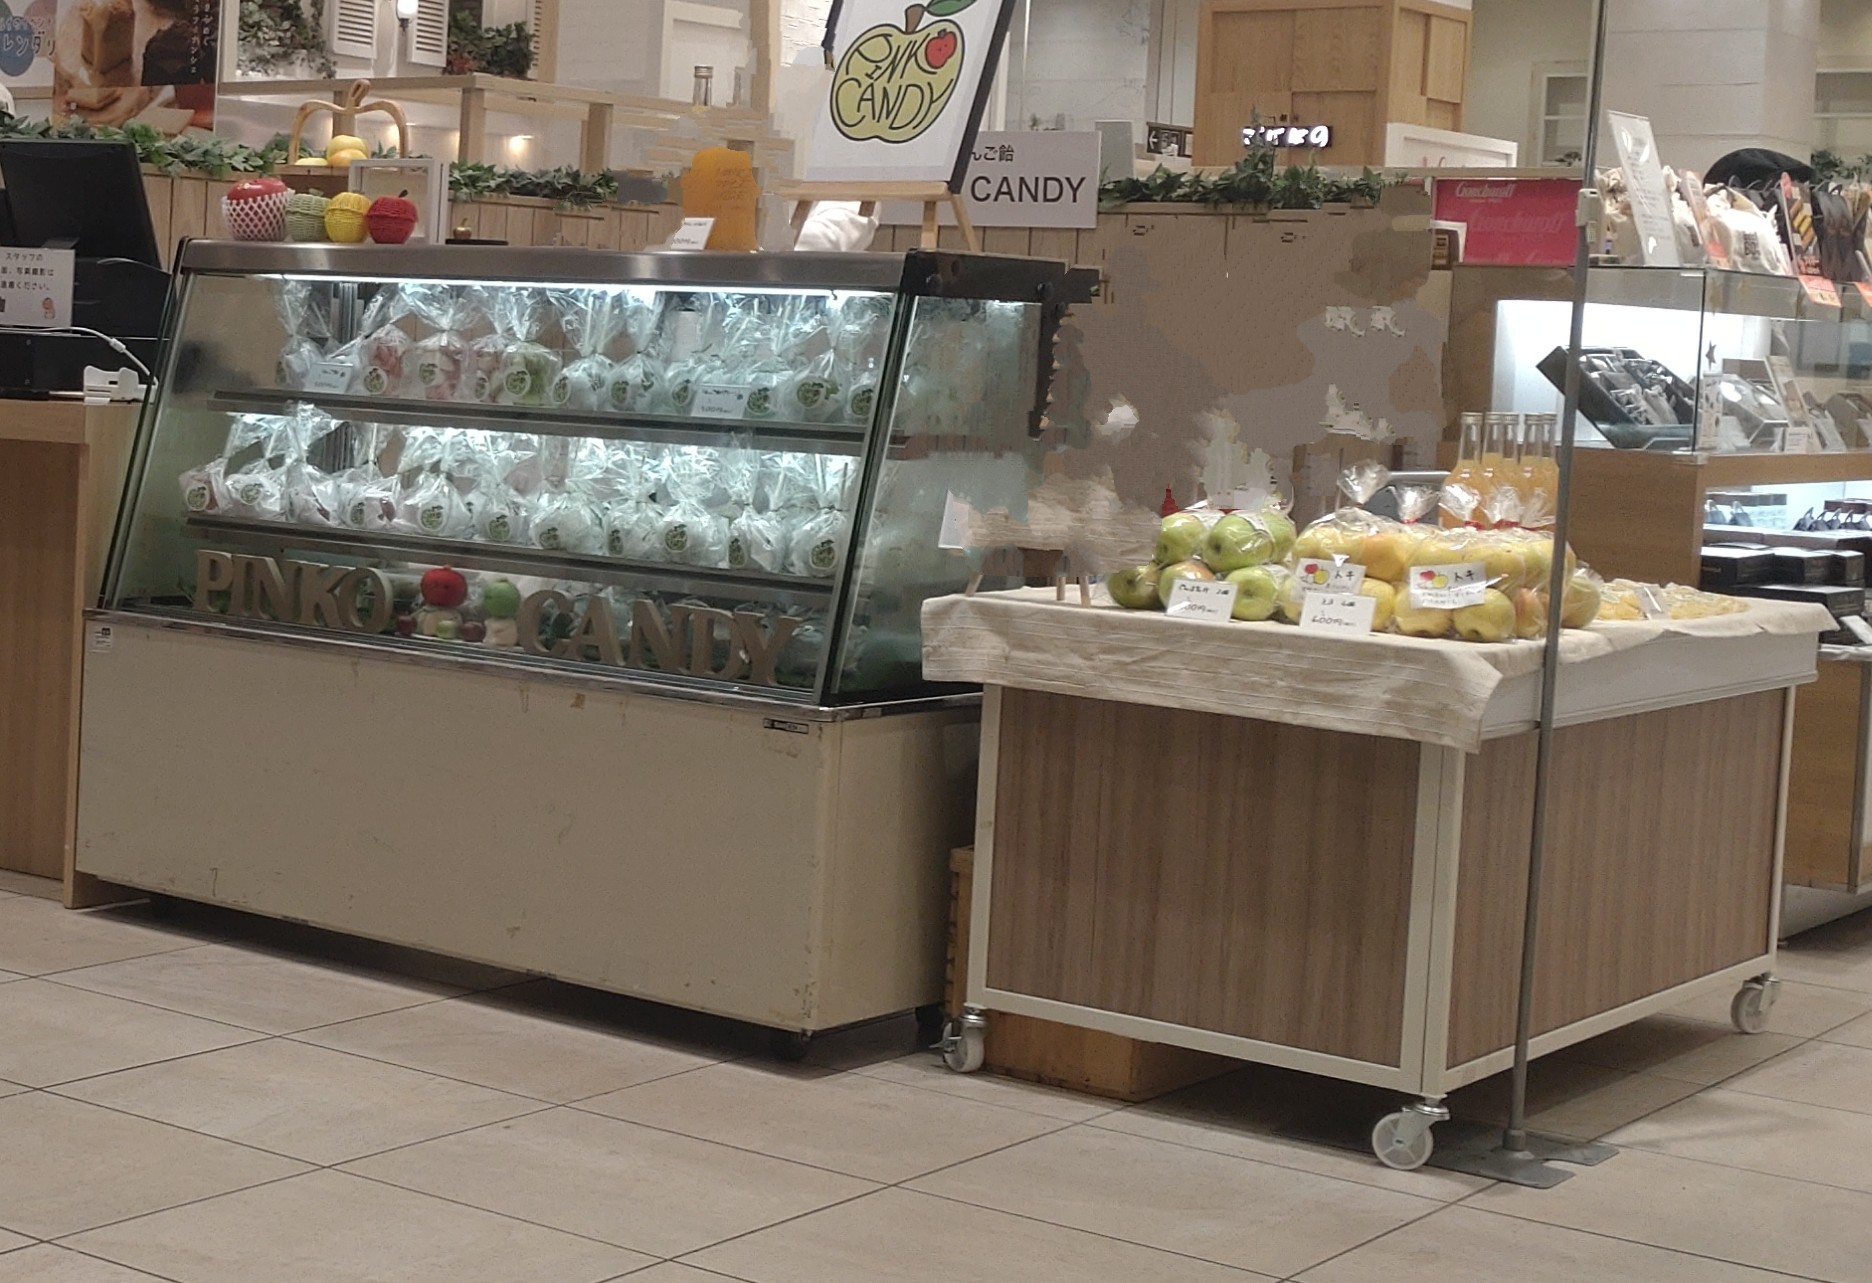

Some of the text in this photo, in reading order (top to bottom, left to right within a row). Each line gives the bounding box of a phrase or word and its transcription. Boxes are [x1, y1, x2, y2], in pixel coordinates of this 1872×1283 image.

[835, 77, 954, 131] CANDY
[971, 175, 1086, 203] CANDY
[193, 550, 803, 687] PINKO CANDY
